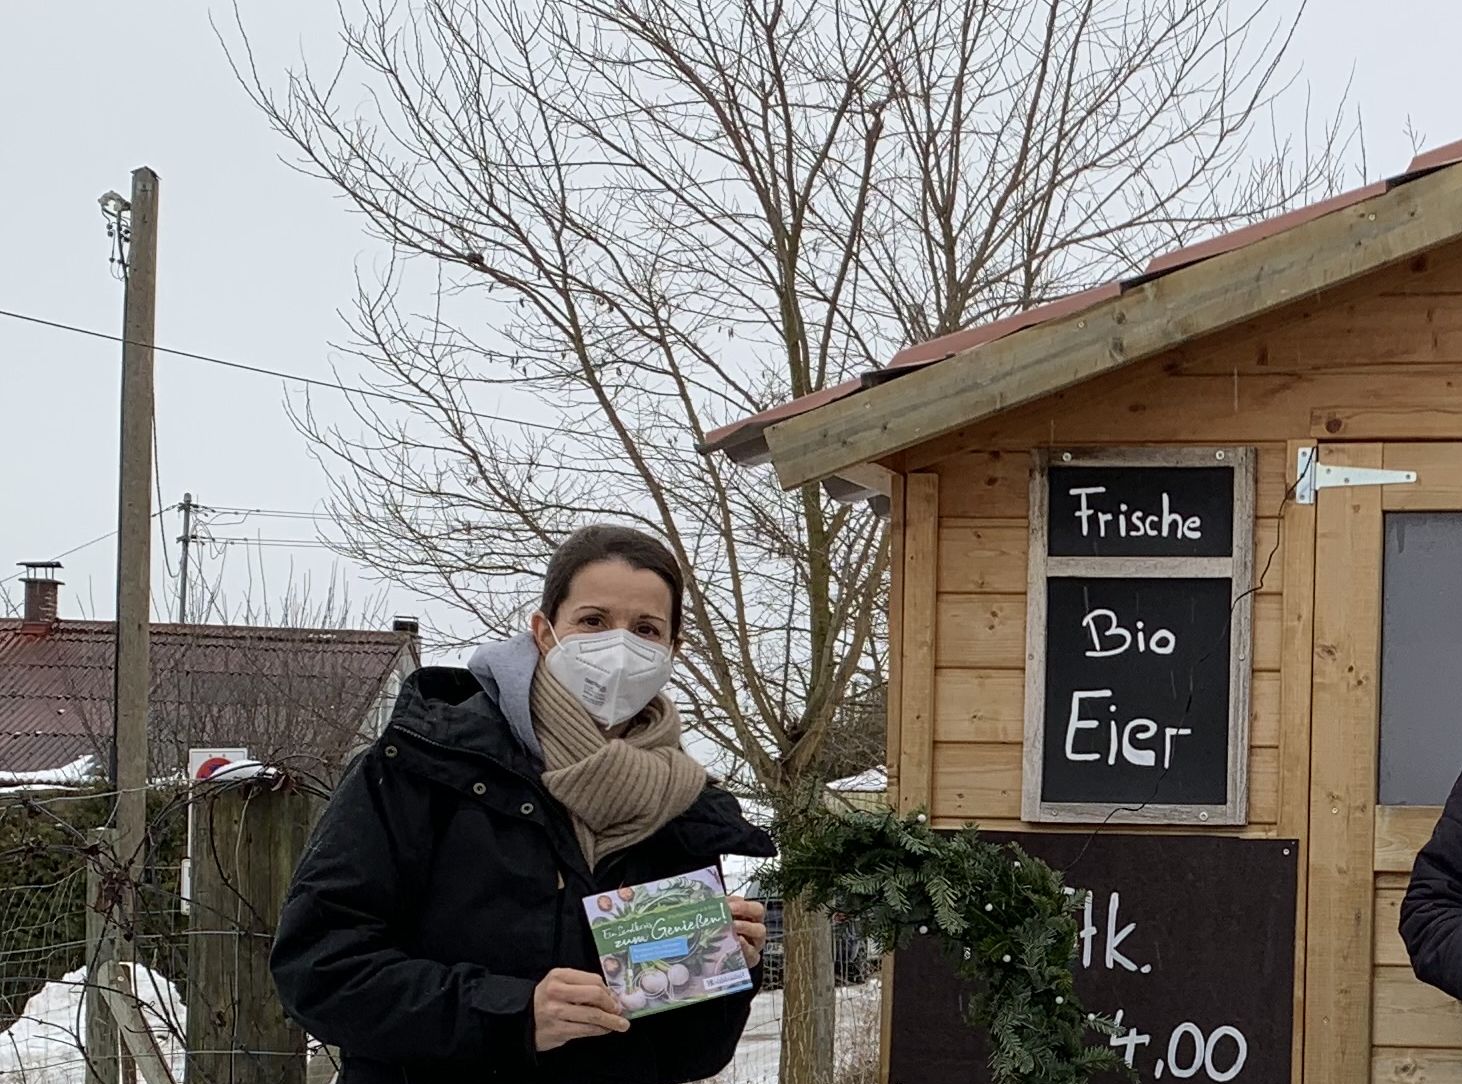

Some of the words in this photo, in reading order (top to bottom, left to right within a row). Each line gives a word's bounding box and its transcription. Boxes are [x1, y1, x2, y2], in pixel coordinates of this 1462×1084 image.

[1069, 486, 1202, 540] Frische
[1082, 608, 1175, 659] Bio
[1064, 689, 1192, 769] Eier
[651, 902, 728, 941] Genießen!
[1064, 885, 1152, 975] tk.
